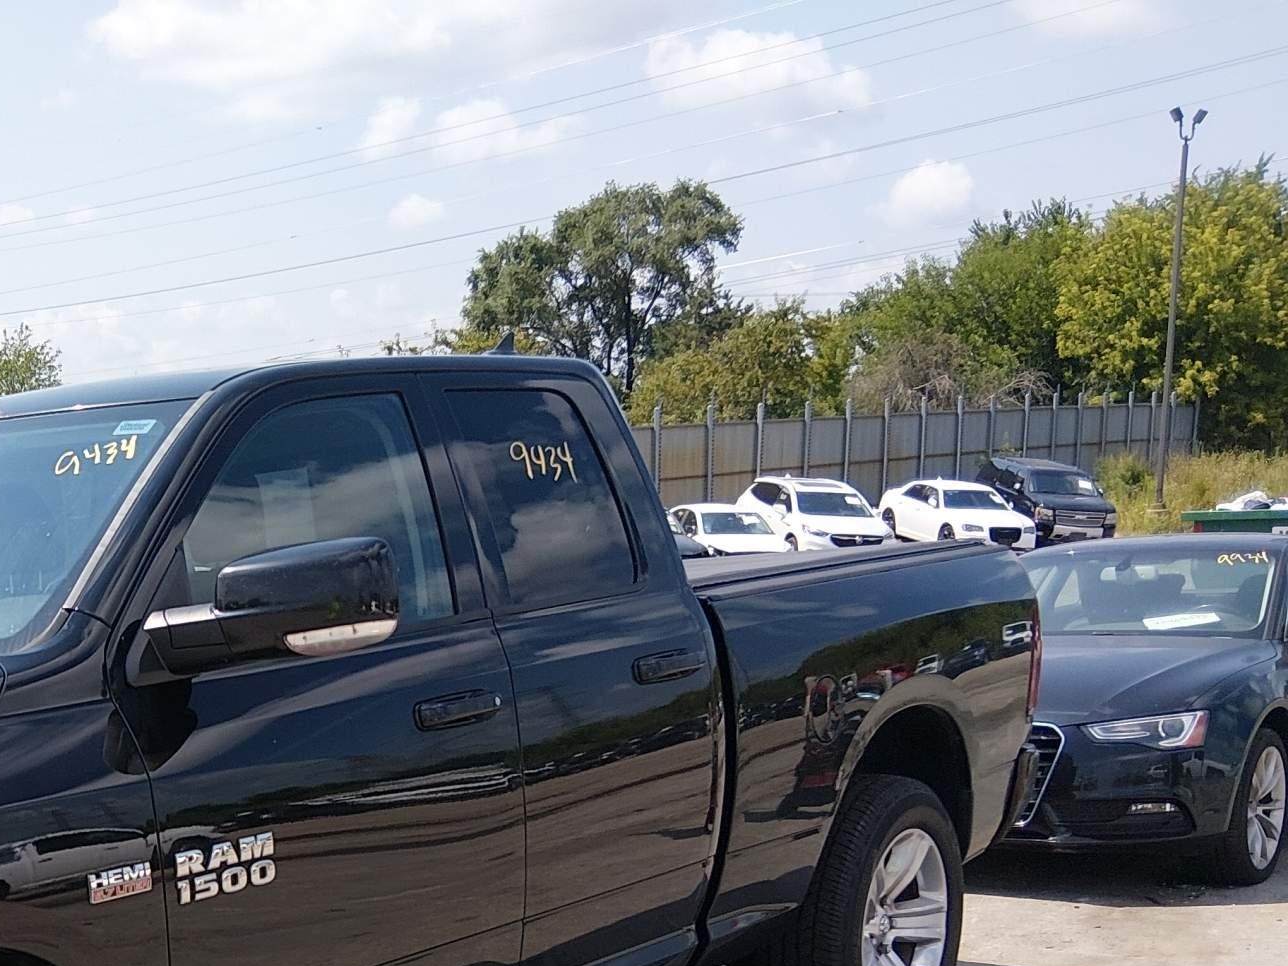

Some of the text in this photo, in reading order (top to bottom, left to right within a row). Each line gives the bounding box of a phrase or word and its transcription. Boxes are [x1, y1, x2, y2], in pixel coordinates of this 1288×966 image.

[55, 434, 138, 475] 9434
[509, 441, 578, 484] 9434
[88, 861, 152, 889] HEMI
[175, 831, 274, 878] RAM
[177, 859, 276, 905] 1500
